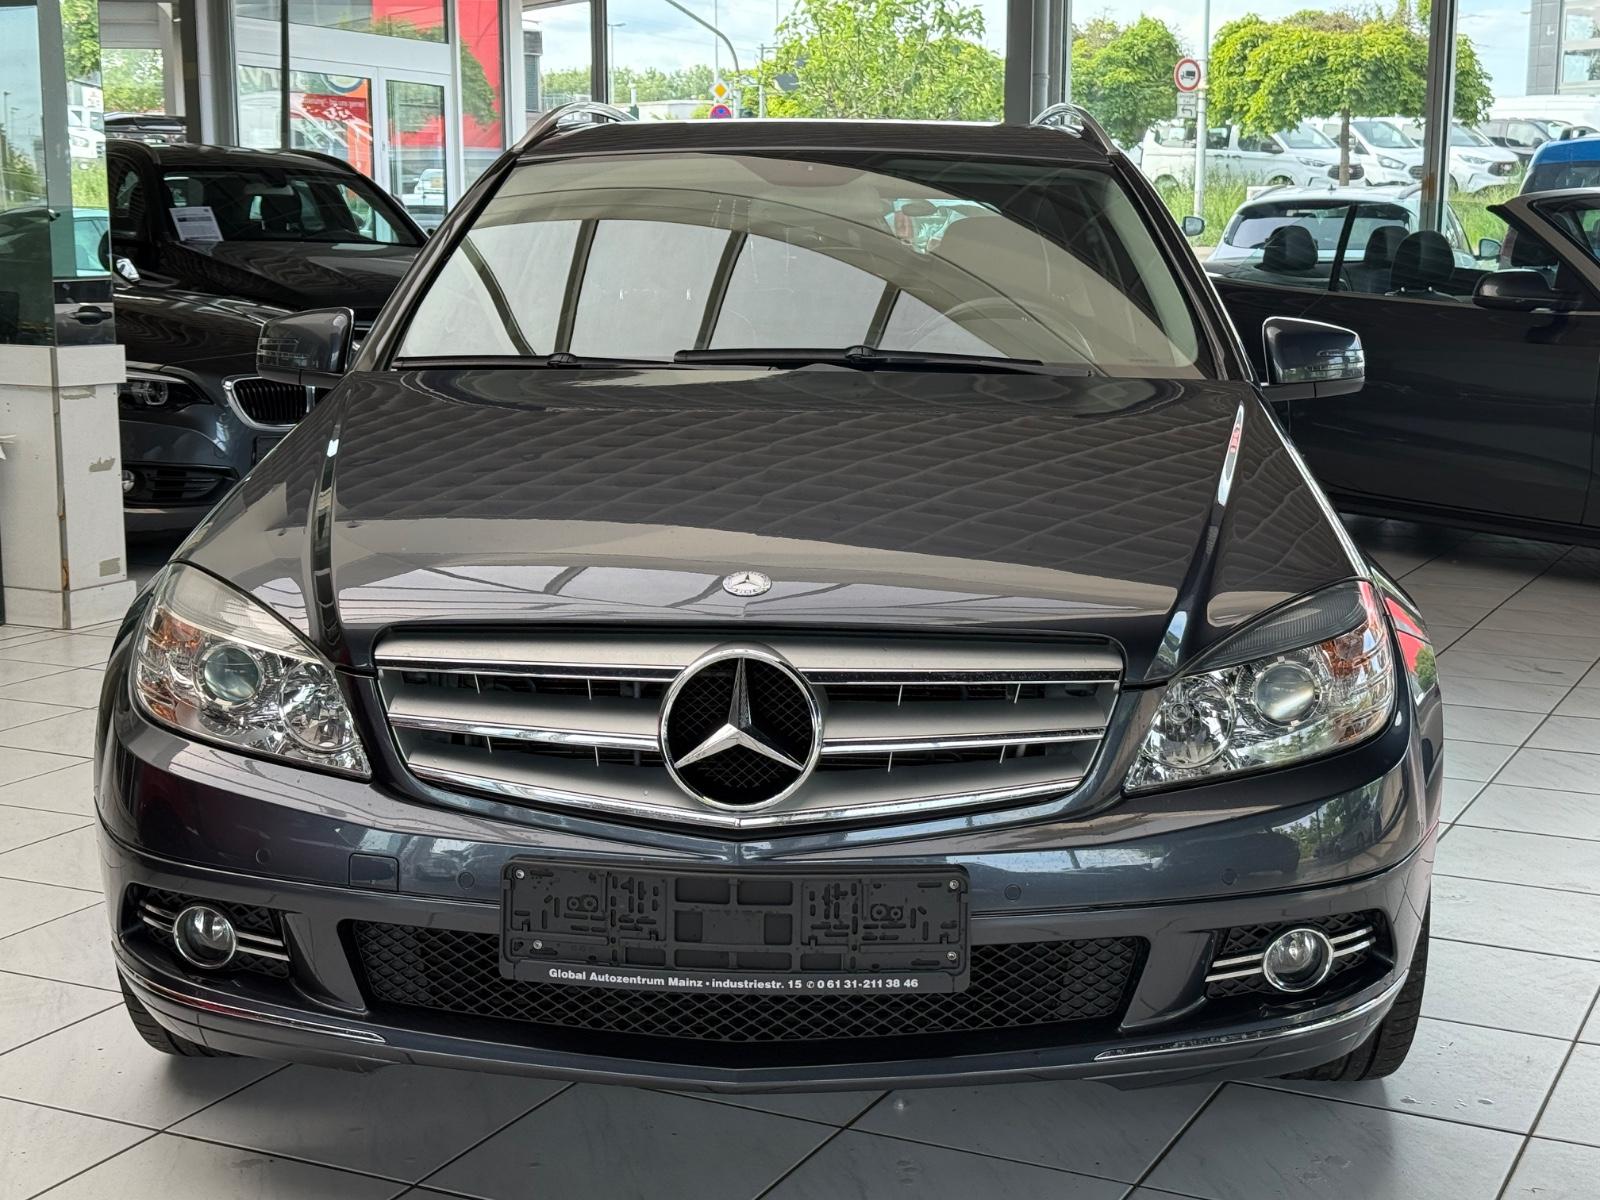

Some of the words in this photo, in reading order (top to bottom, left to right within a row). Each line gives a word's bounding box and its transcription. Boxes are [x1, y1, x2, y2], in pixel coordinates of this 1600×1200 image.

[548, 968, 587, 980] Global
[590, 972, 665, 986] Autozentrum
[668, 977, 703, 987] Mainz
[712, 978, 785, 989] industriestr.
[788, 979, 803, 989] 15
[904, 978, 919, 988] 46
